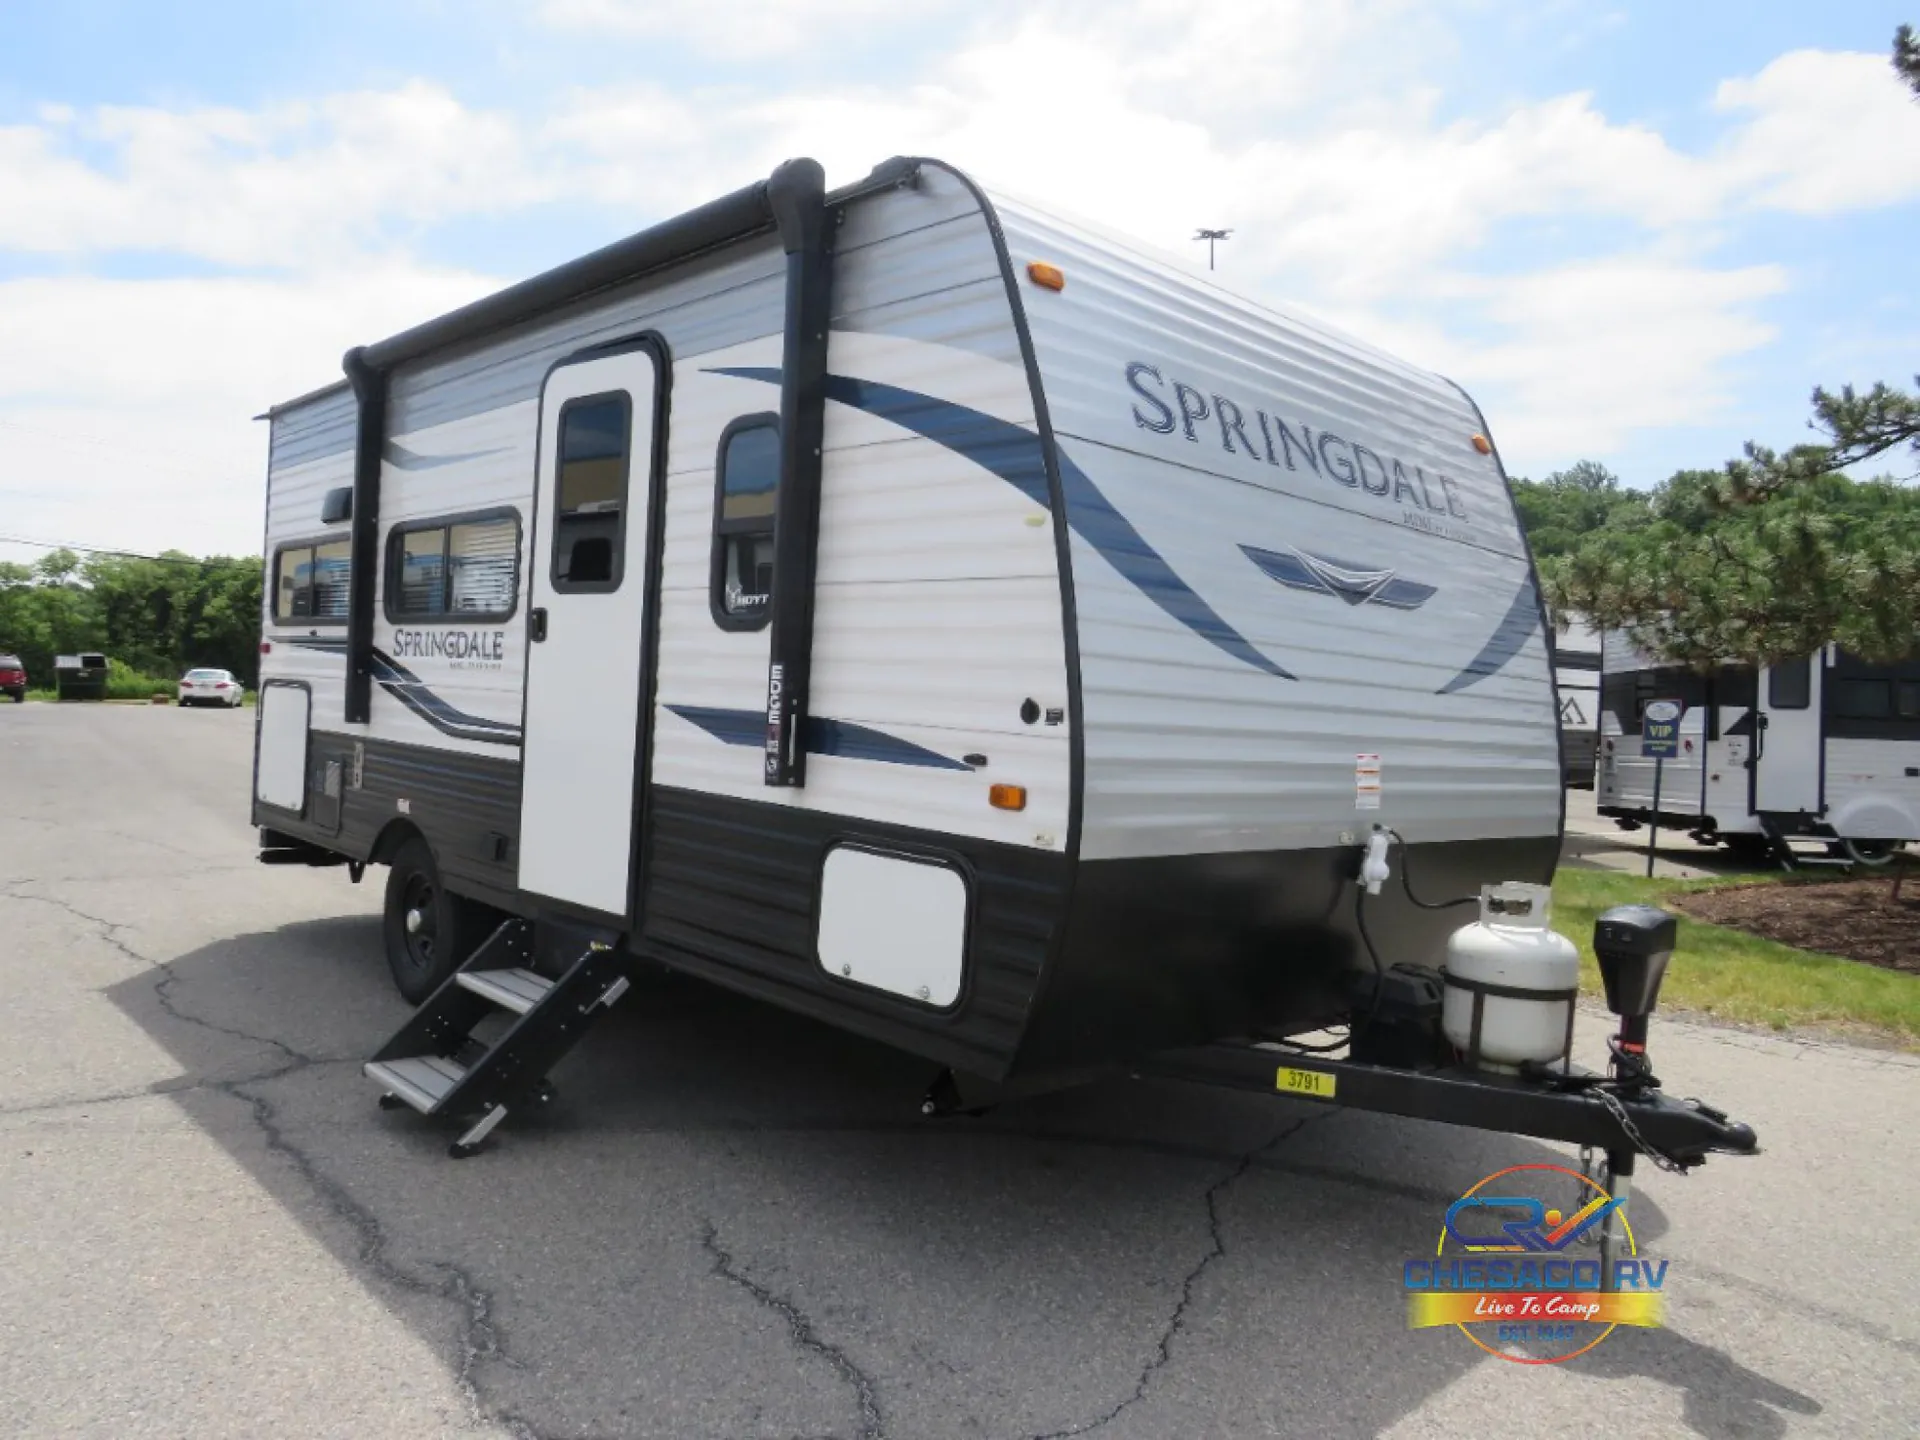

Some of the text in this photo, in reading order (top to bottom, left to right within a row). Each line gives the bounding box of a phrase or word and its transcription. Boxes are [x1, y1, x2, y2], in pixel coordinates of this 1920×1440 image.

[1125, 361, 1466, 522] SPRINGDALE
[393, 628, 504, 660] SPRINGDALE
[1649, 725, 1673, 738] VIP
[1288, 1070, 1319, 1091] 3791
